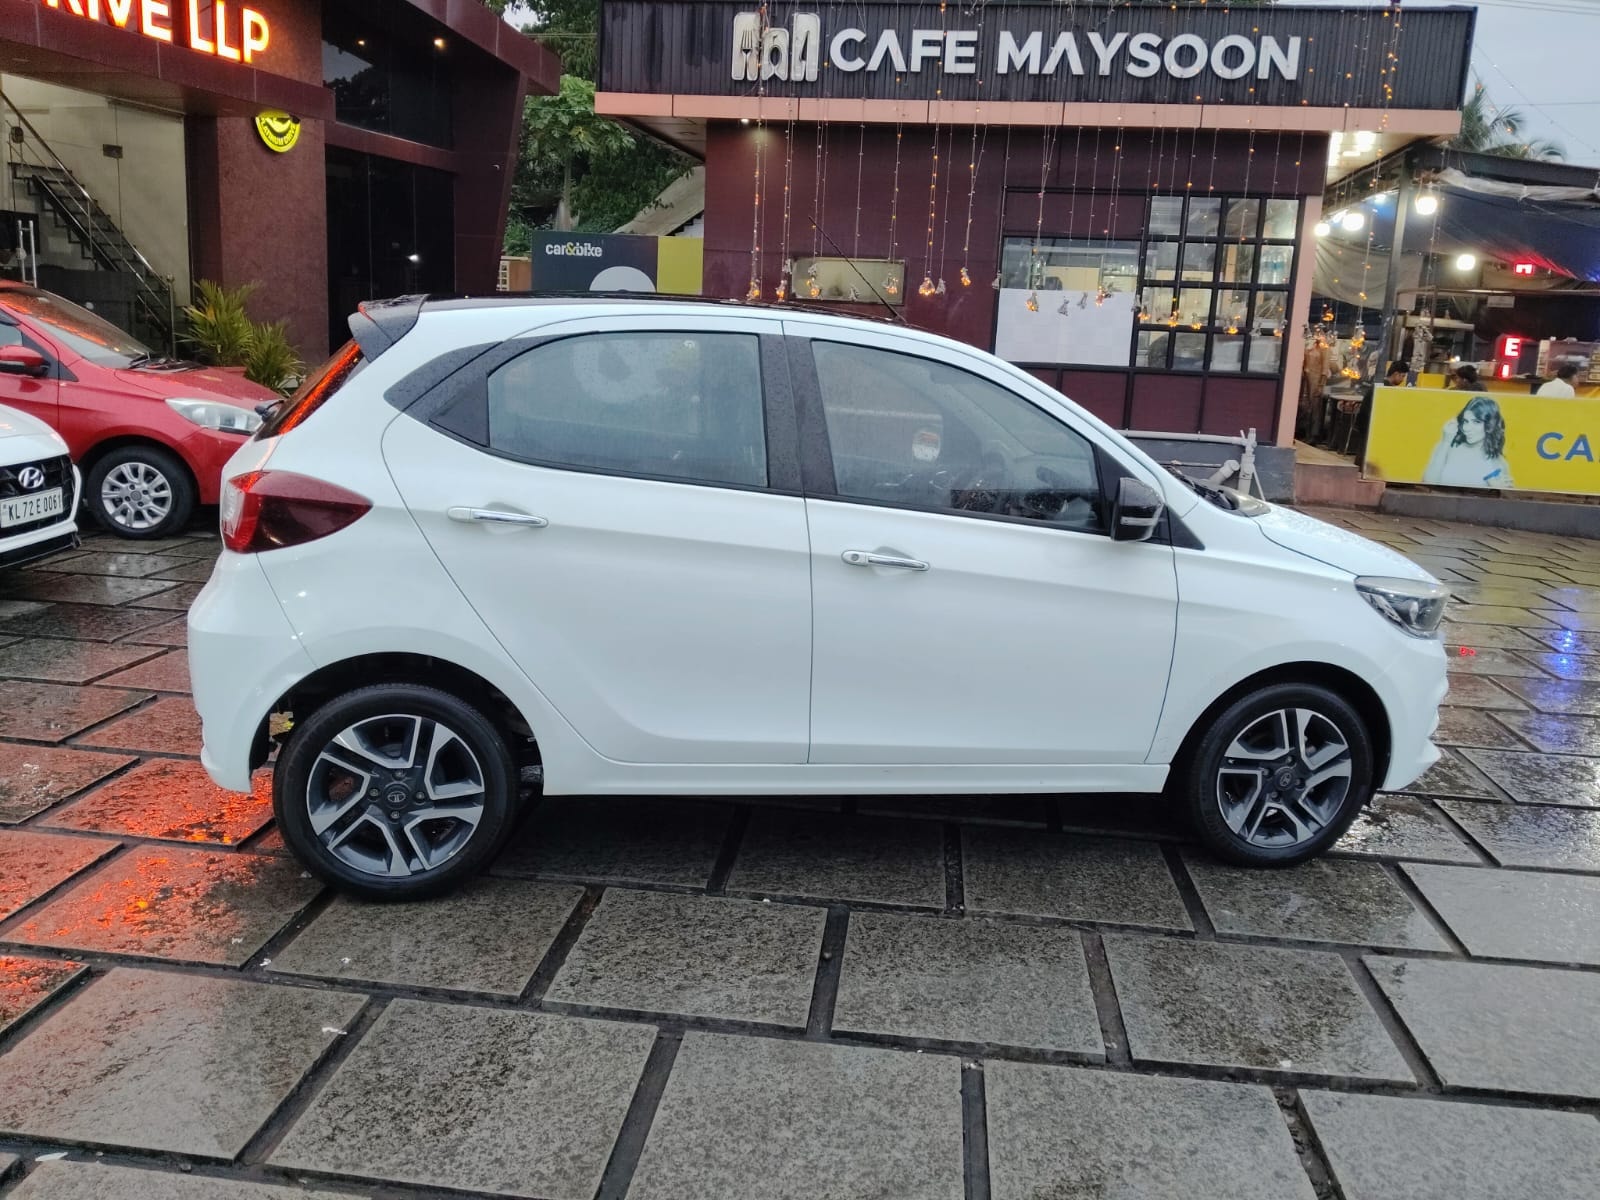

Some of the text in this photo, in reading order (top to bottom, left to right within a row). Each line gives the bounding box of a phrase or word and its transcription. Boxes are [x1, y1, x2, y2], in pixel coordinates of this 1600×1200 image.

[44, 0, 270, 63] VE LLP
[830, 28, 1301, 80] CAFE MAYSOON
[545, 241, 603, 257] car&bike
[1536, 431, 1600, 462] CA
[9, 503, 20, 521] KL
[23, 500, 34, 518] 72
[36, 498, 41, 514] E
